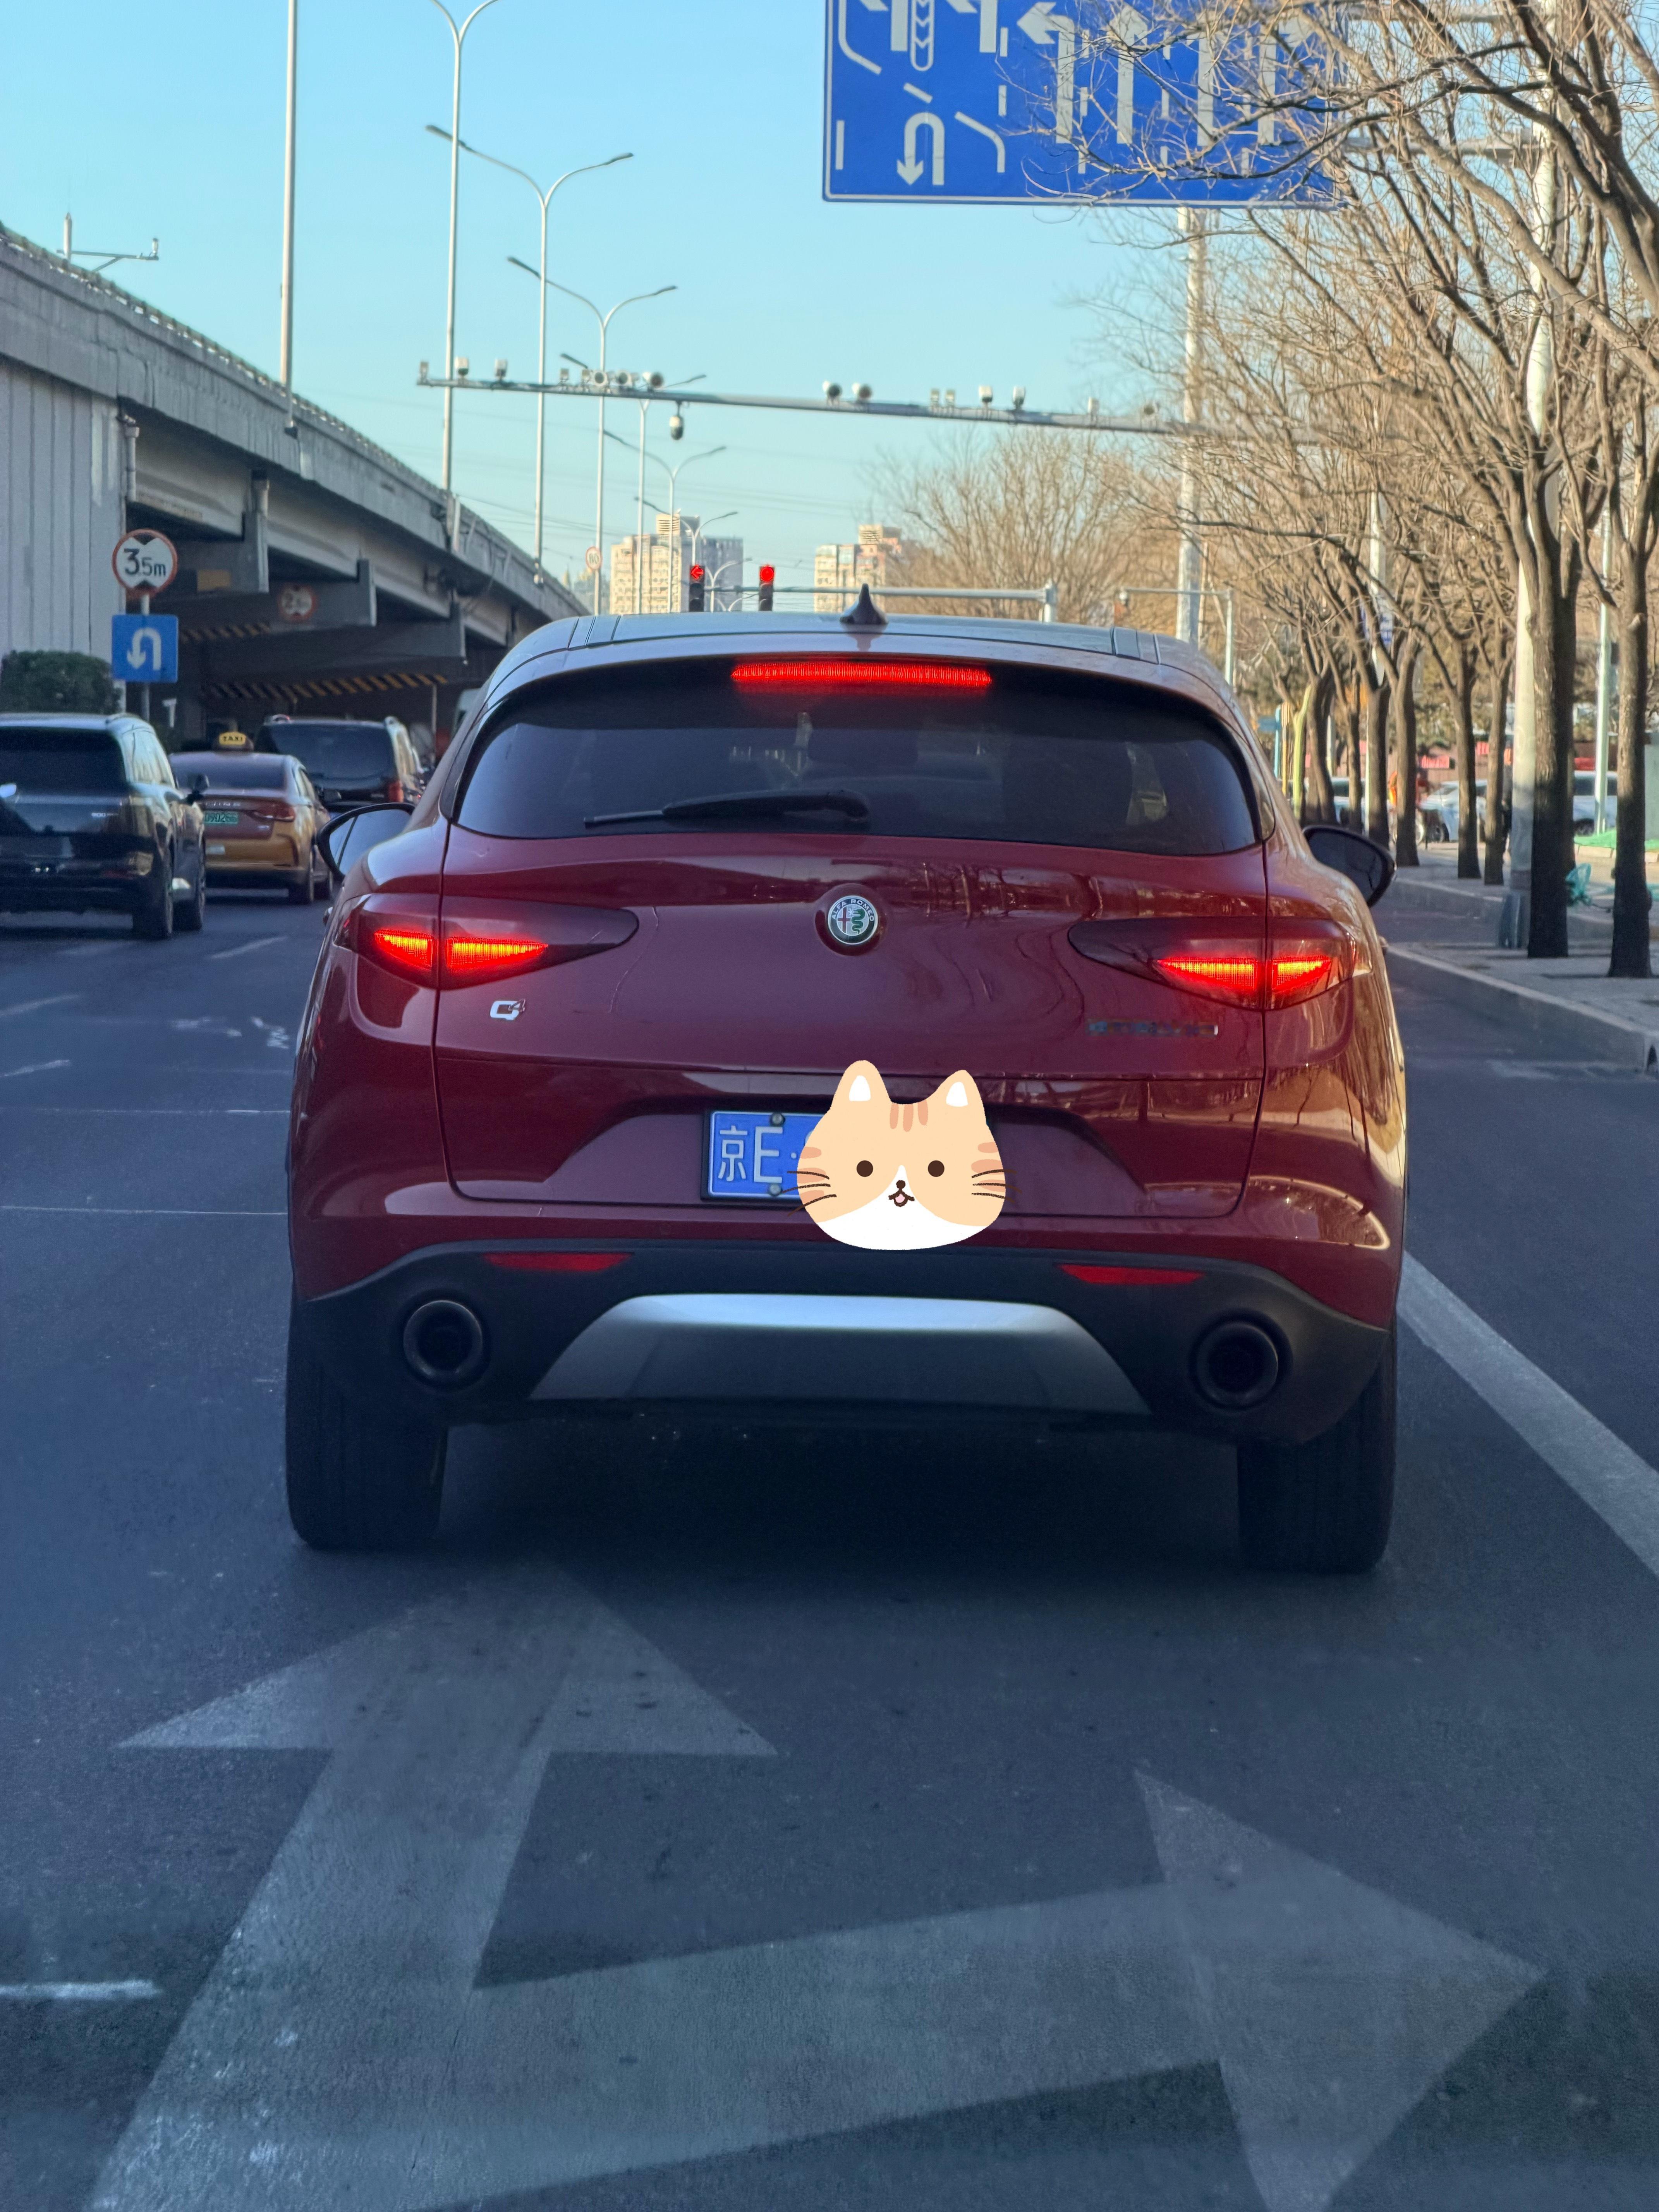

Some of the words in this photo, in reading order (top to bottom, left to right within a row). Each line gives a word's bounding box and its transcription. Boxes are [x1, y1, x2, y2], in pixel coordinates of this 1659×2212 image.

[831, 901, 847, 920] ALFA
[851, 899, 874, 921] ROMEO
[718, 1125, 814, 1183] 京E·
